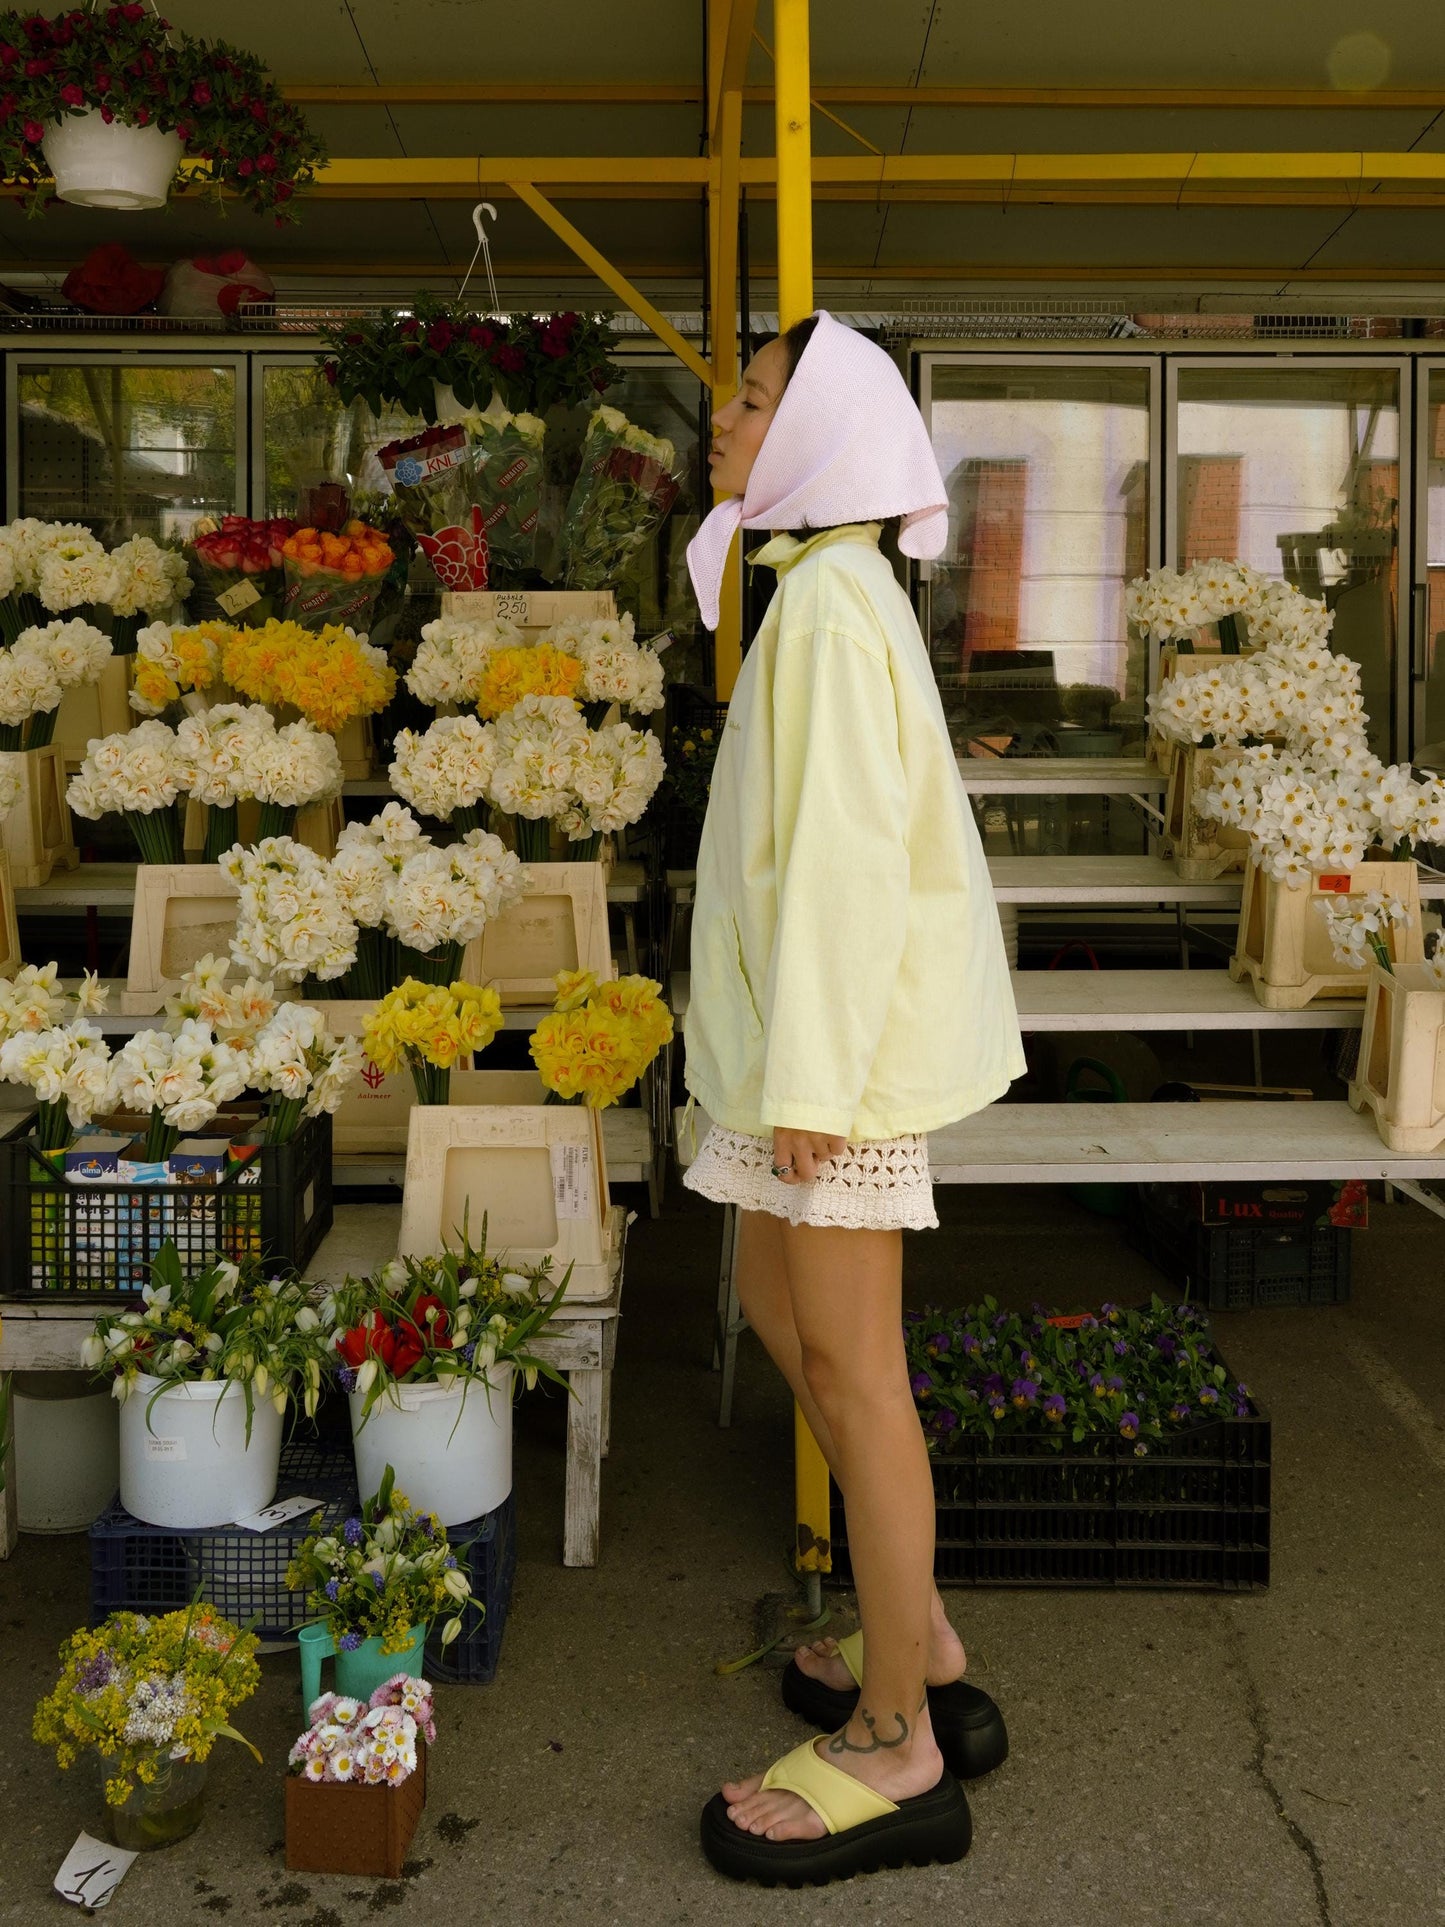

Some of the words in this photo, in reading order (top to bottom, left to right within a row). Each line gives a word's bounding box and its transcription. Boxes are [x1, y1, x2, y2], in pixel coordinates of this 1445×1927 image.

[499, 459, 527, 486] TIMAFLOR
[483, 503, 508, 529] IMAFLOR
[357, 1092, 392, 1100] Aalsmeer
[81, 1167, 101, 1175] alma
[1217, 1197, 1265, 1218] Lux
